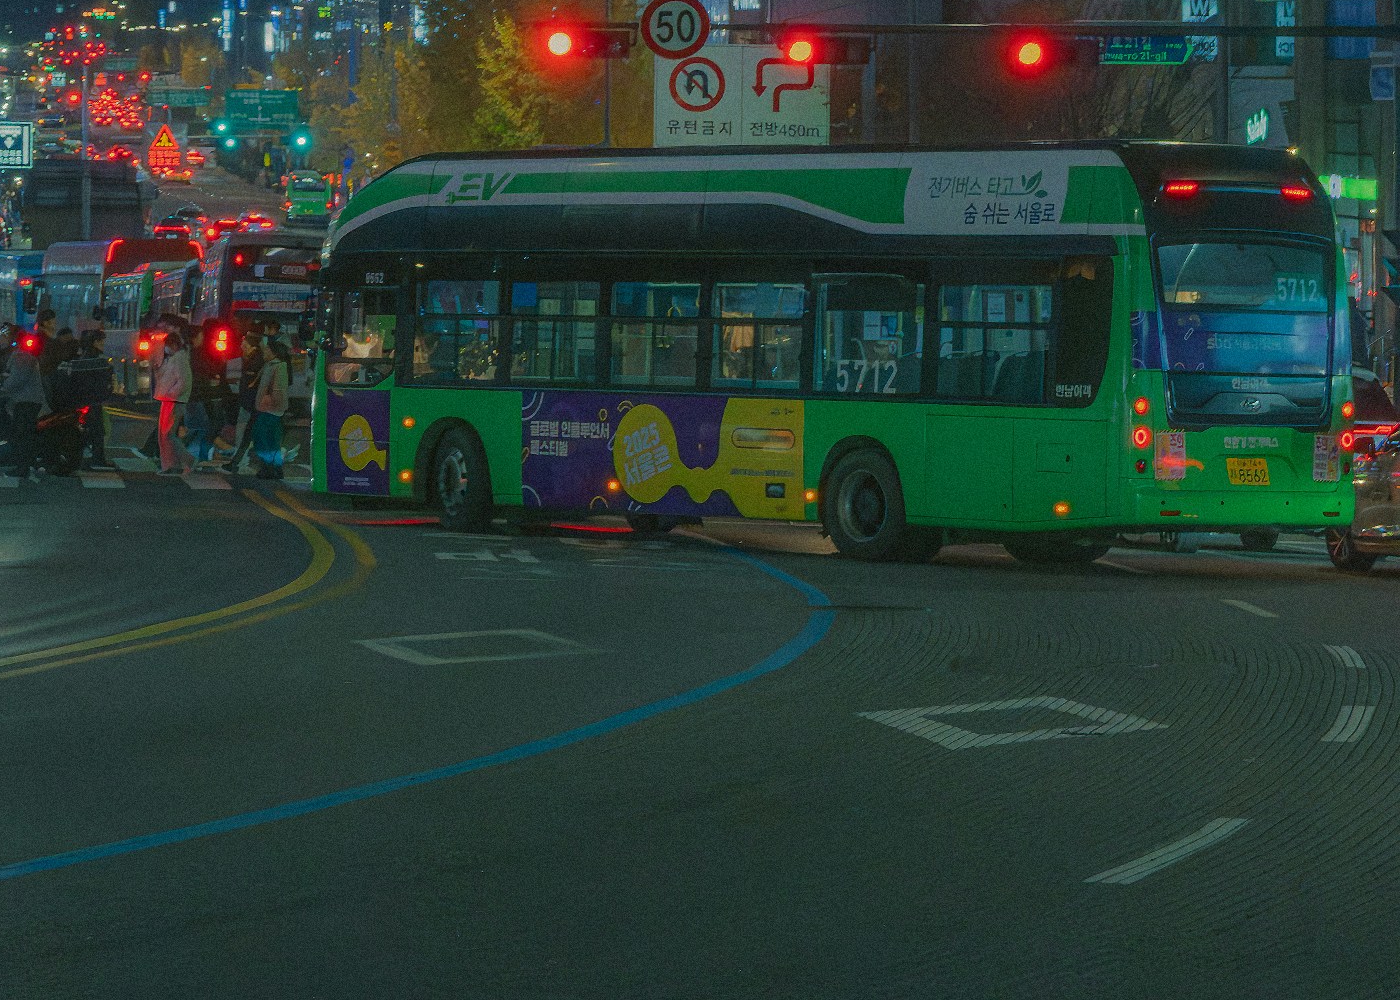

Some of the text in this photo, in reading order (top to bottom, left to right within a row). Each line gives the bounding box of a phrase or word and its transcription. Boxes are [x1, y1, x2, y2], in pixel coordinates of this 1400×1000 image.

[656, 10, 695, 43] 50
[667, 119, 733, 136] 유턴금지
[749, 121, 820, 138] 전방450m
[460, 173, 506, 200] EV
[928, 177, 1014, 199] 전기버스 타고
[964, 203, 1056, 224] 숨 쉬는 서울로
[1276, 278, 1318, 301] 5712
[836, 360, 898, 394] 5712
[530, 420, 610, 439] 글로벌 인플루언서
[623, 422, 660, 457] 2025
[530, 440, 568, 457] 페스티벌
